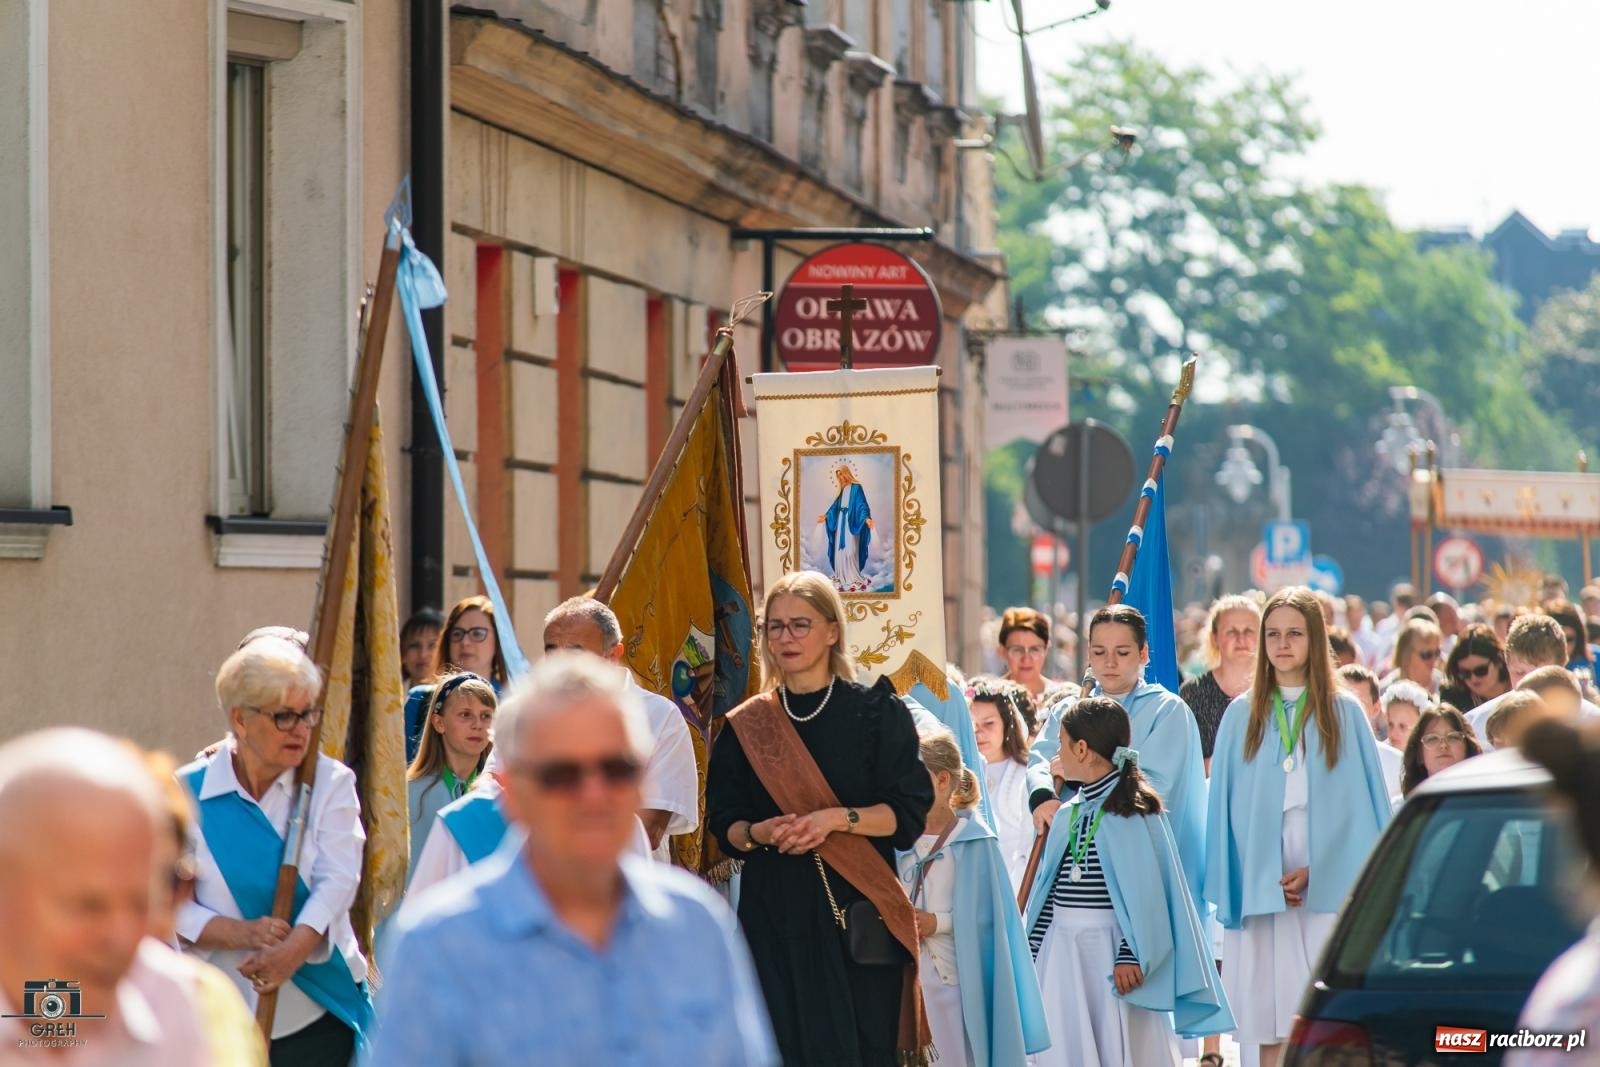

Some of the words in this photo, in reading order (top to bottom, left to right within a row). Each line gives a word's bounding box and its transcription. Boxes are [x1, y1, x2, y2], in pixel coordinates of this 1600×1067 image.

[808, 263, 875, 279] NOWINY
[877, 264, 910, 280] ART
[795, 296, 920, 321] OPAWA
[1272, 525, 1302, 562] P
